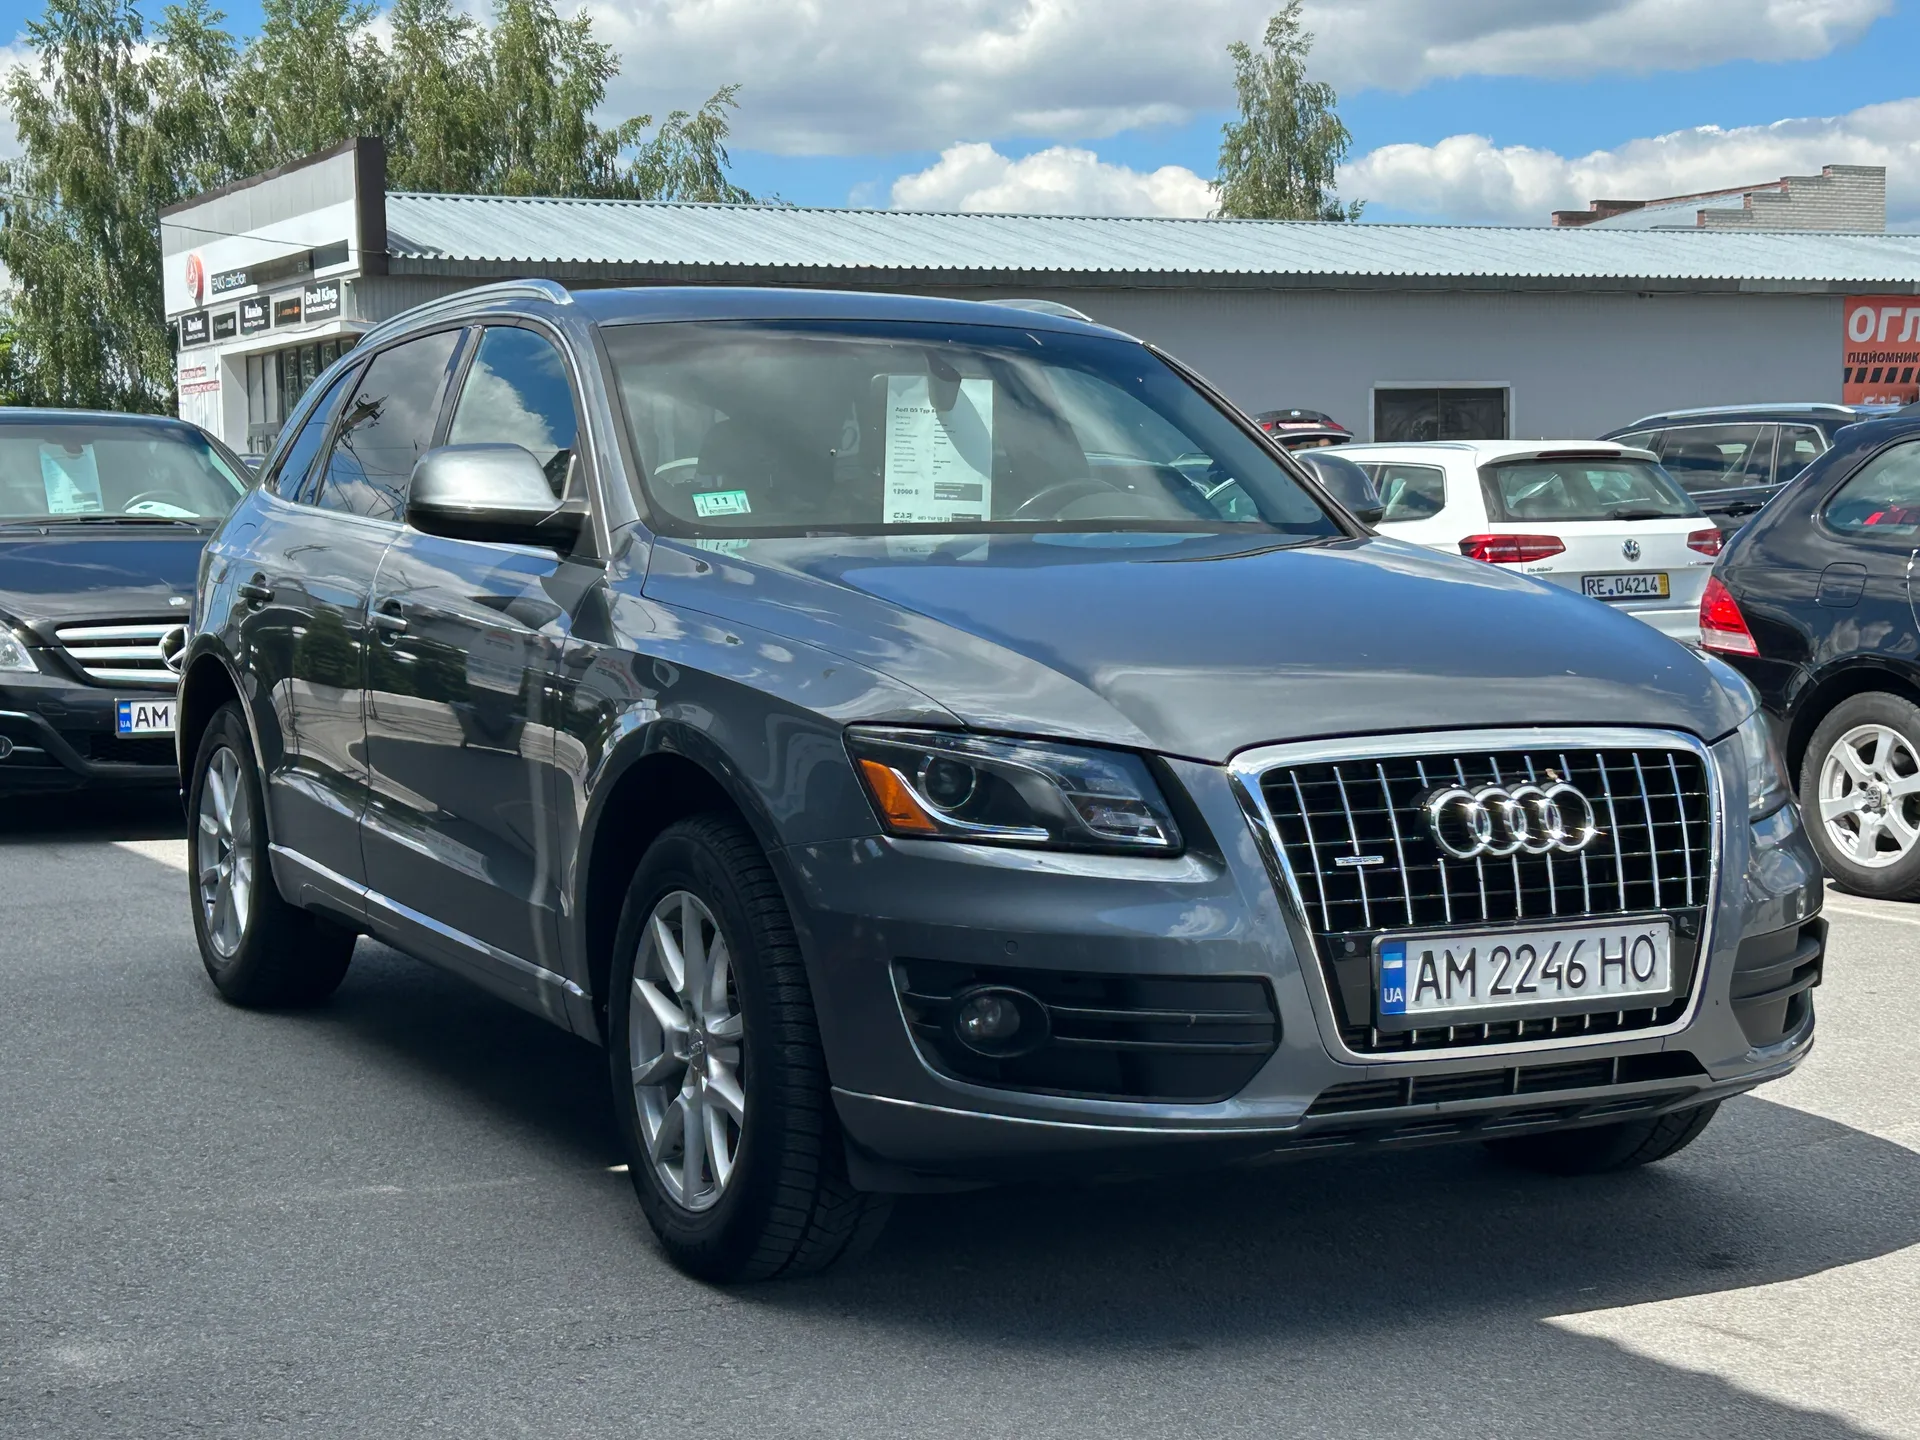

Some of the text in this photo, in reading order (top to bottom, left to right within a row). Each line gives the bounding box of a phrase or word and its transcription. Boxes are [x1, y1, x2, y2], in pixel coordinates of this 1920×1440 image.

[1847, 350, 1920, 364] ПІДЙОМНИК
[713, 497, 728, 505] 11
[135, 706, 168, 728] AM
[1411, 934, 1656, 1002] AM 2246 HO
[1383, 987, 1404, 1003] UA
